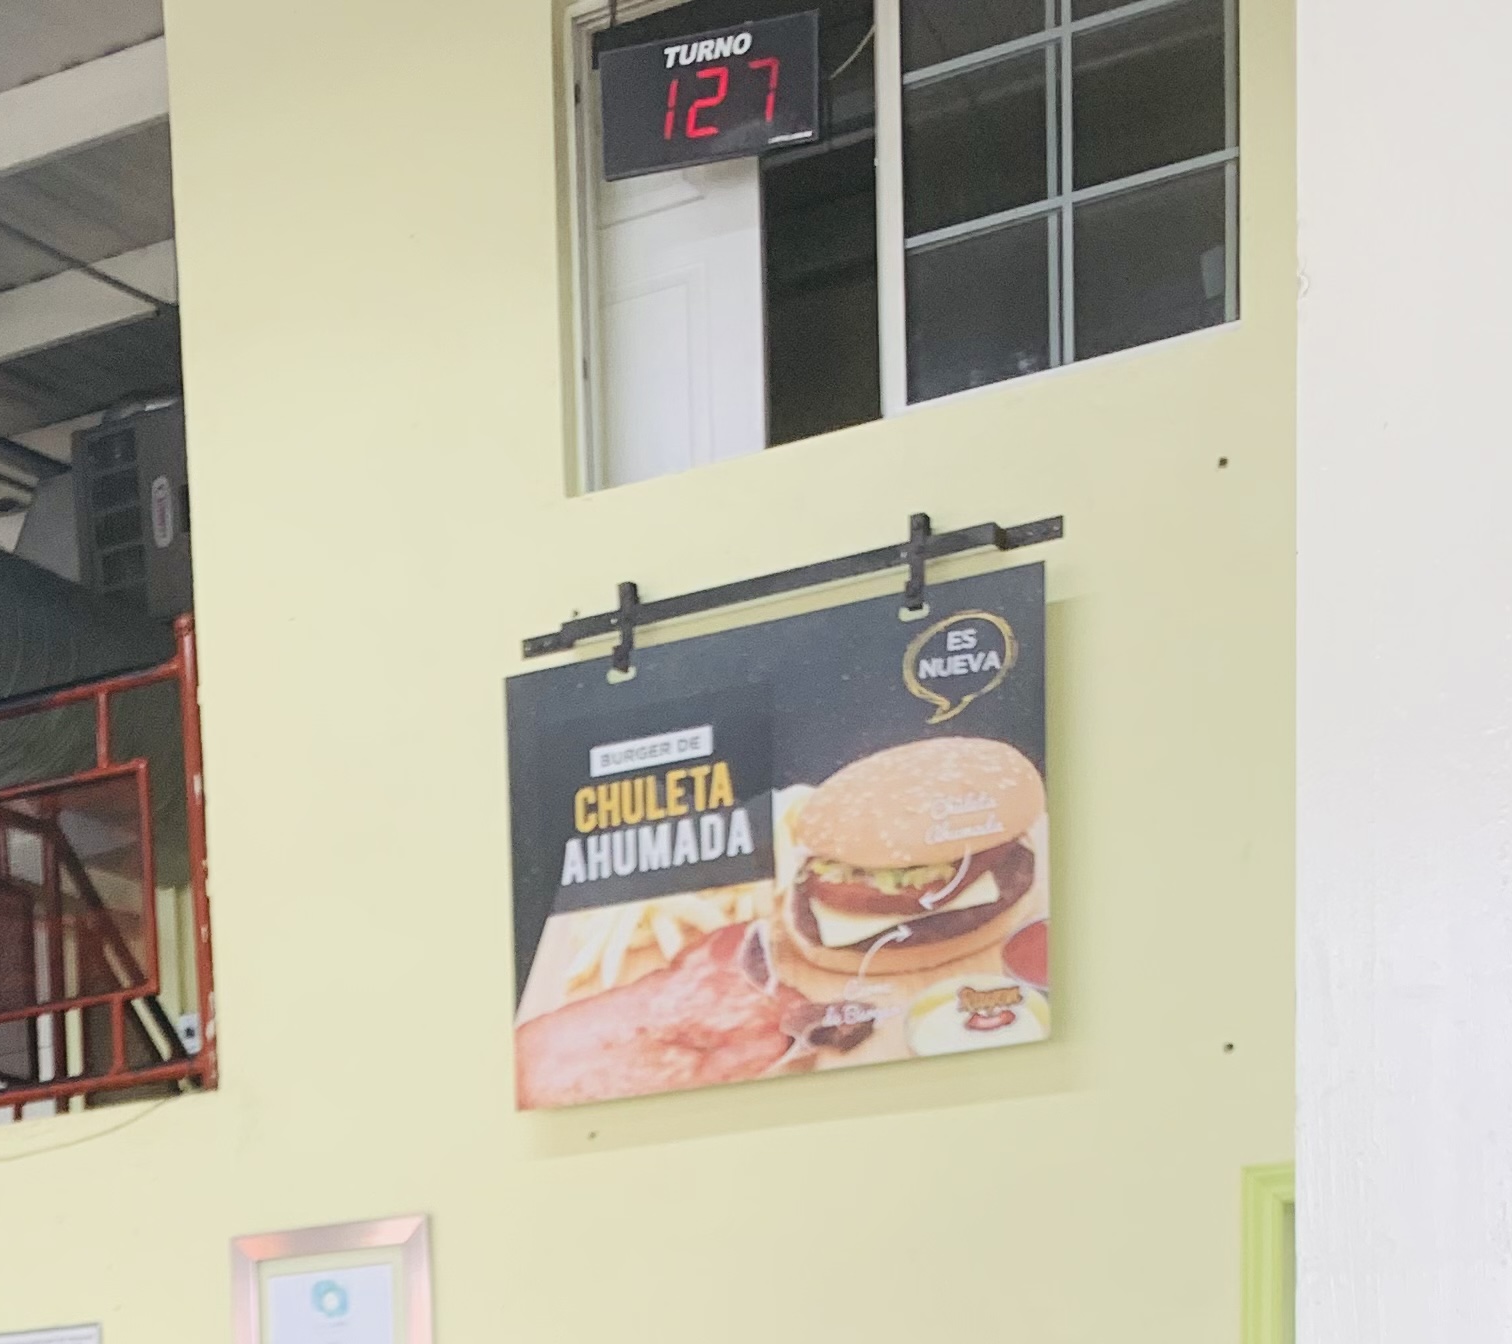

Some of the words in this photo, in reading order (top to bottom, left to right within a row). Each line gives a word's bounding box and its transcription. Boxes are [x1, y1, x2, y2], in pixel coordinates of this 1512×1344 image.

[663, 32, 753, 69] TURNO
[663, 56, 781, 140] 127
[946, 627, 978, 652] ES
[918, 650, 1002, 680] NUEVA
[600, 741, 672, 768] BURGER
[677, 735, 702, 751] DE
[574, 760, 736, 834] CHULETA
[561, 806, 755, 887] AHUMADA
